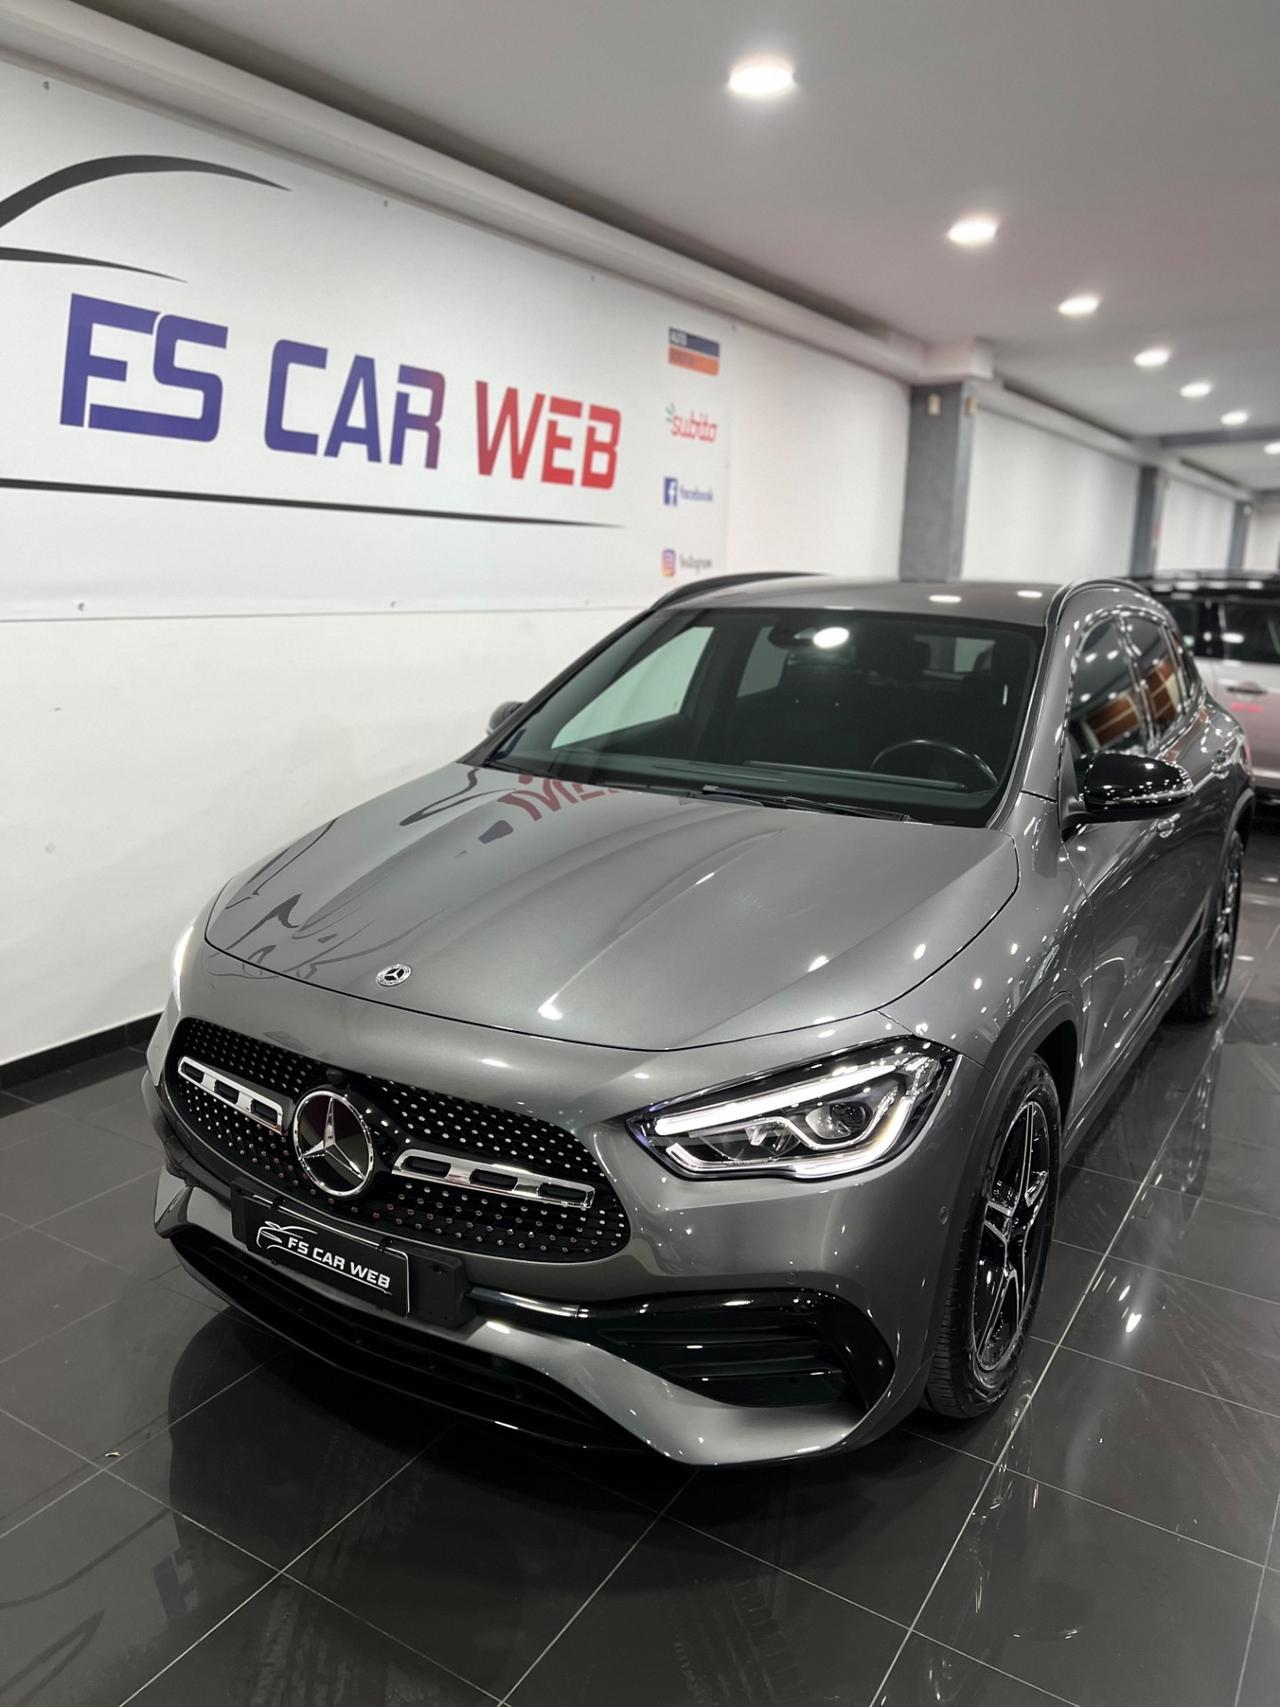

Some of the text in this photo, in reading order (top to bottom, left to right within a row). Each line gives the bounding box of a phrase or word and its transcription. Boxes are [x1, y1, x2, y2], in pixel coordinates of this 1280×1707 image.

[264, 339, 446, 470] CAR
[475, 380, 622, 490] WEB
[288, 1237, 391, 1289] FS CAR WEB
